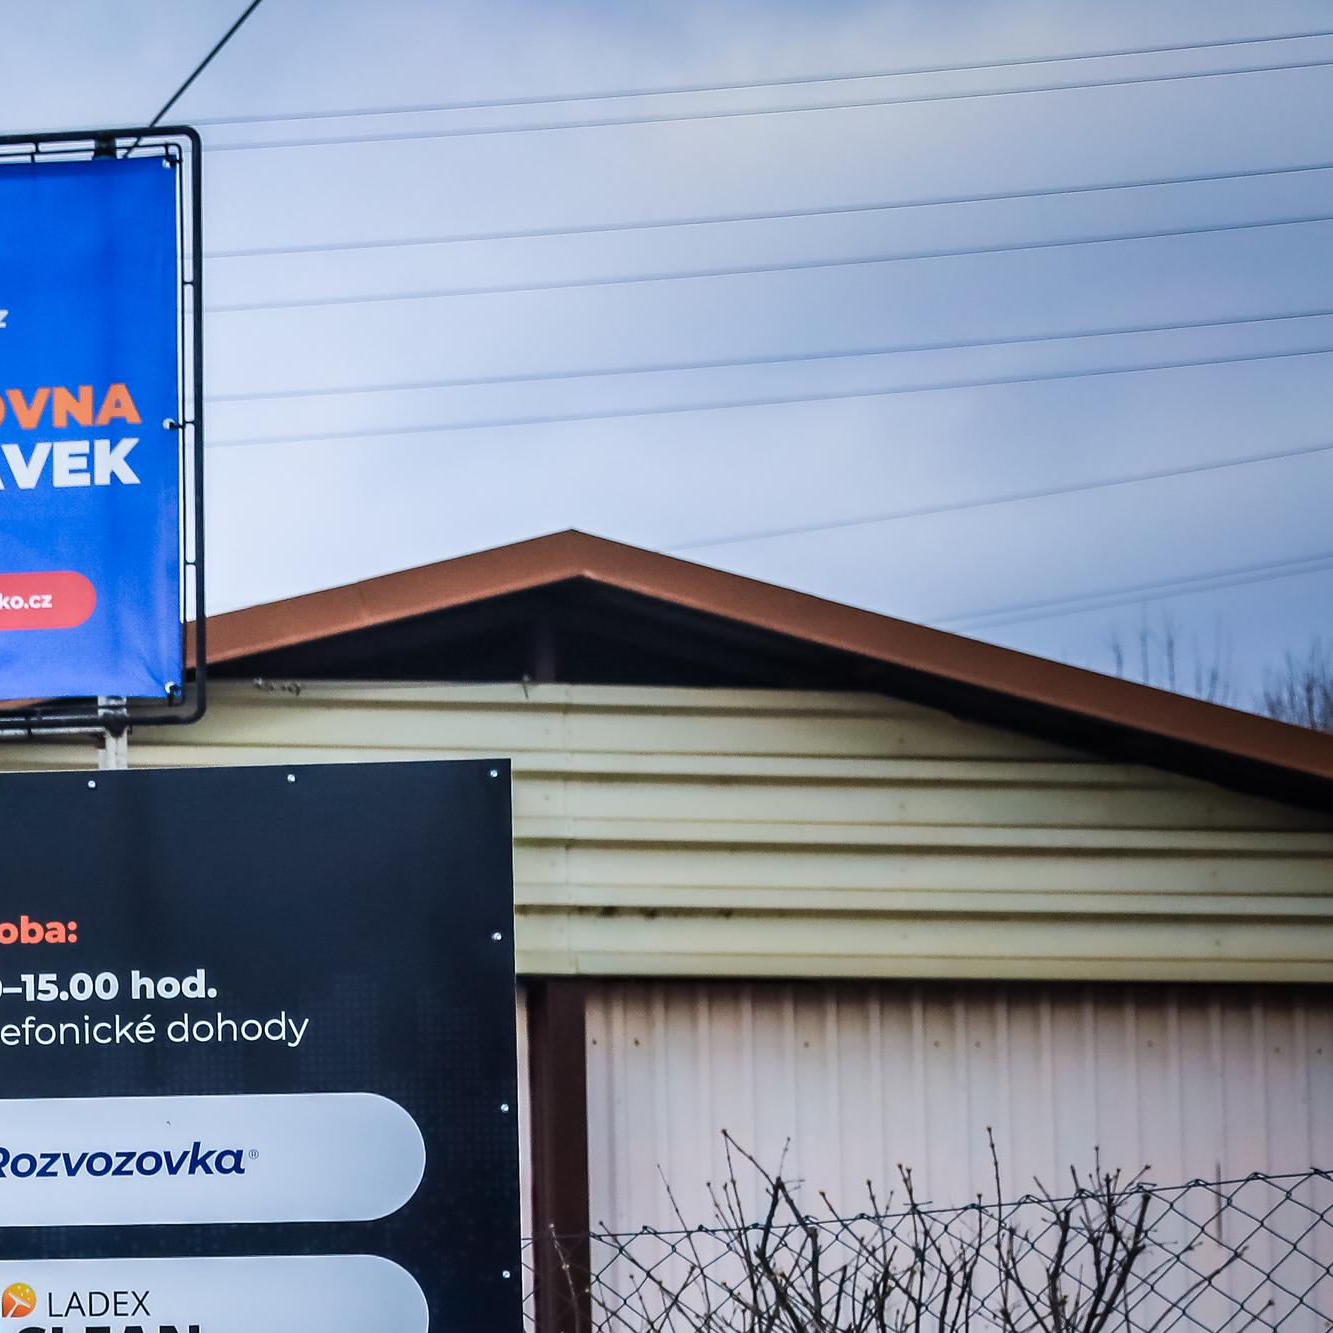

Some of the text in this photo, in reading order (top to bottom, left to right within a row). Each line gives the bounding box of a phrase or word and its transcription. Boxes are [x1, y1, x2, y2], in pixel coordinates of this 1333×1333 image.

[132, 969, 217, 999] hod.
[168, 1011, 309, 1047] dohody
[49, 1291, 150, 1317] LADEX
